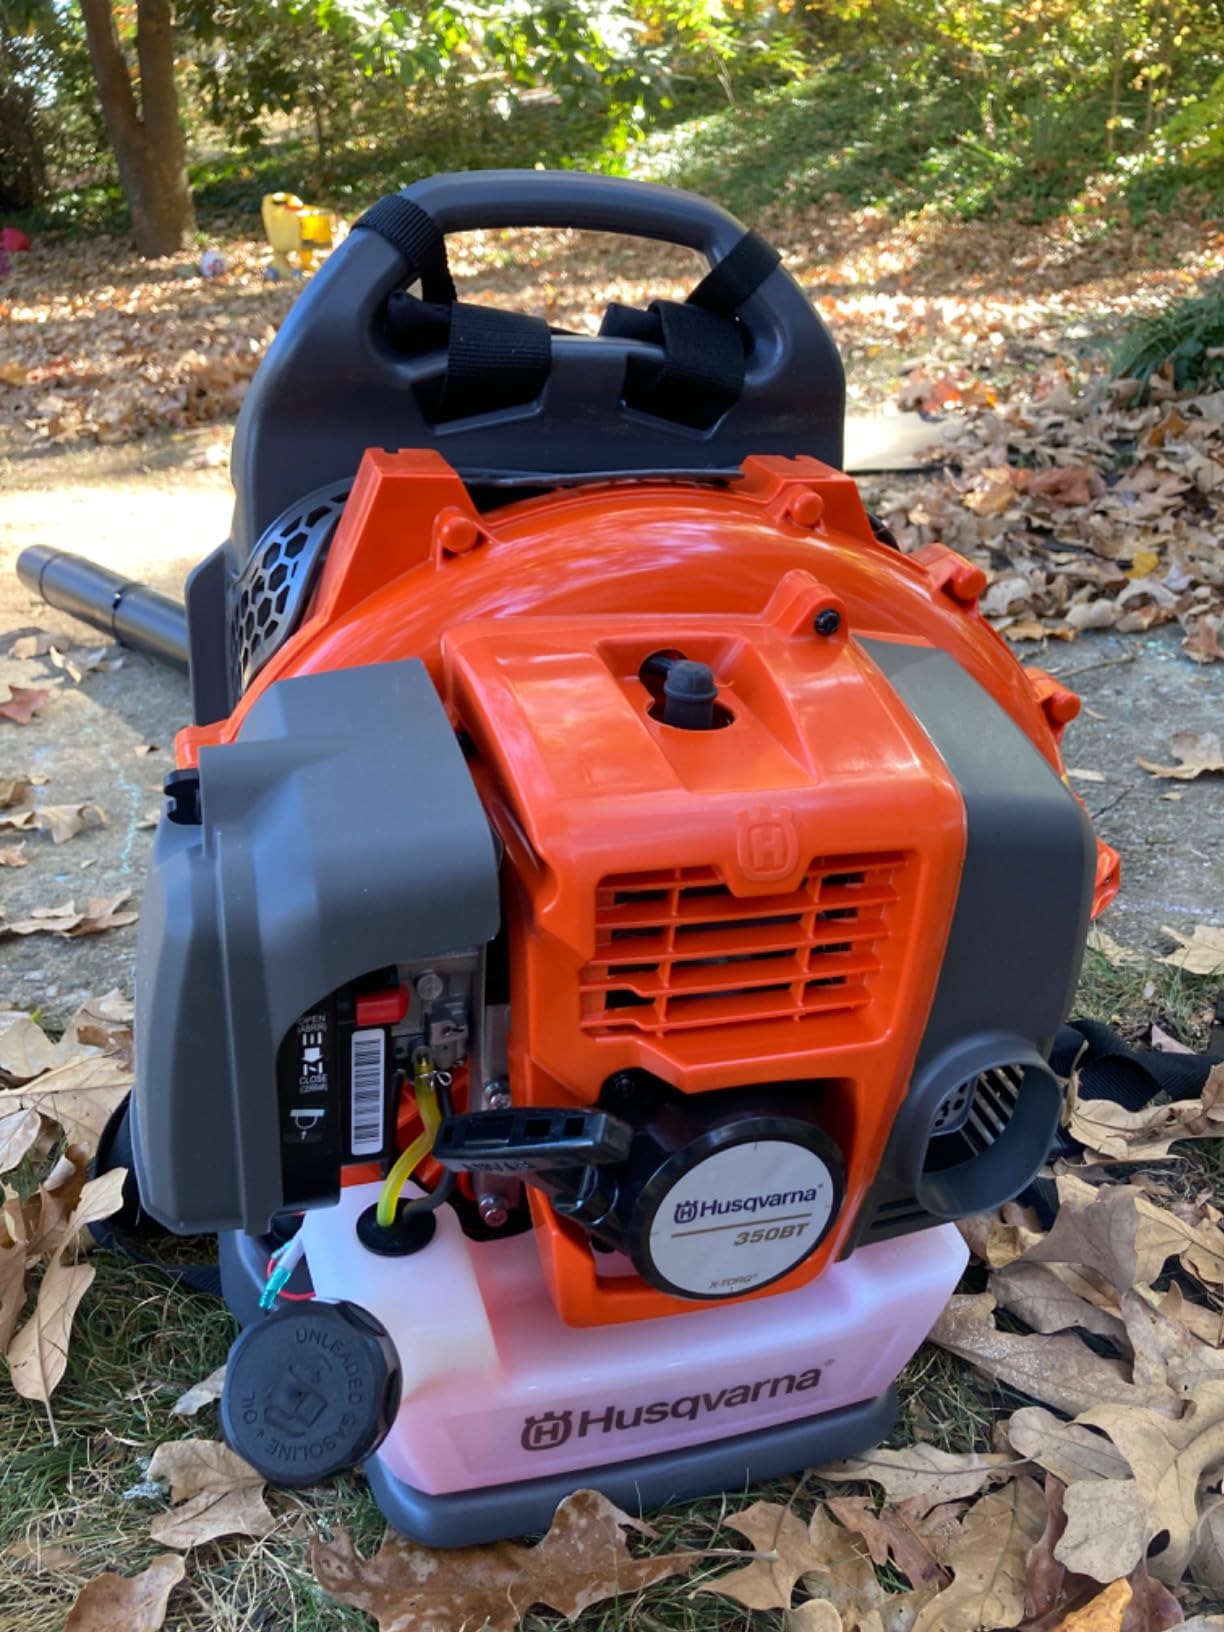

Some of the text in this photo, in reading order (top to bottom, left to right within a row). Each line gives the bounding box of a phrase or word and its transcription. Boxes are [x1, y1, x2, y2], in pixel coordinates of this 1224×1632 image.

[699, 1187, 817, 1218] Husqvarna
[734, 1223, 810, 1247] 350BT
[296, 1328, 363, 1405] UNLEADED
[577, 1368, 822, 1437] Husqvarna
